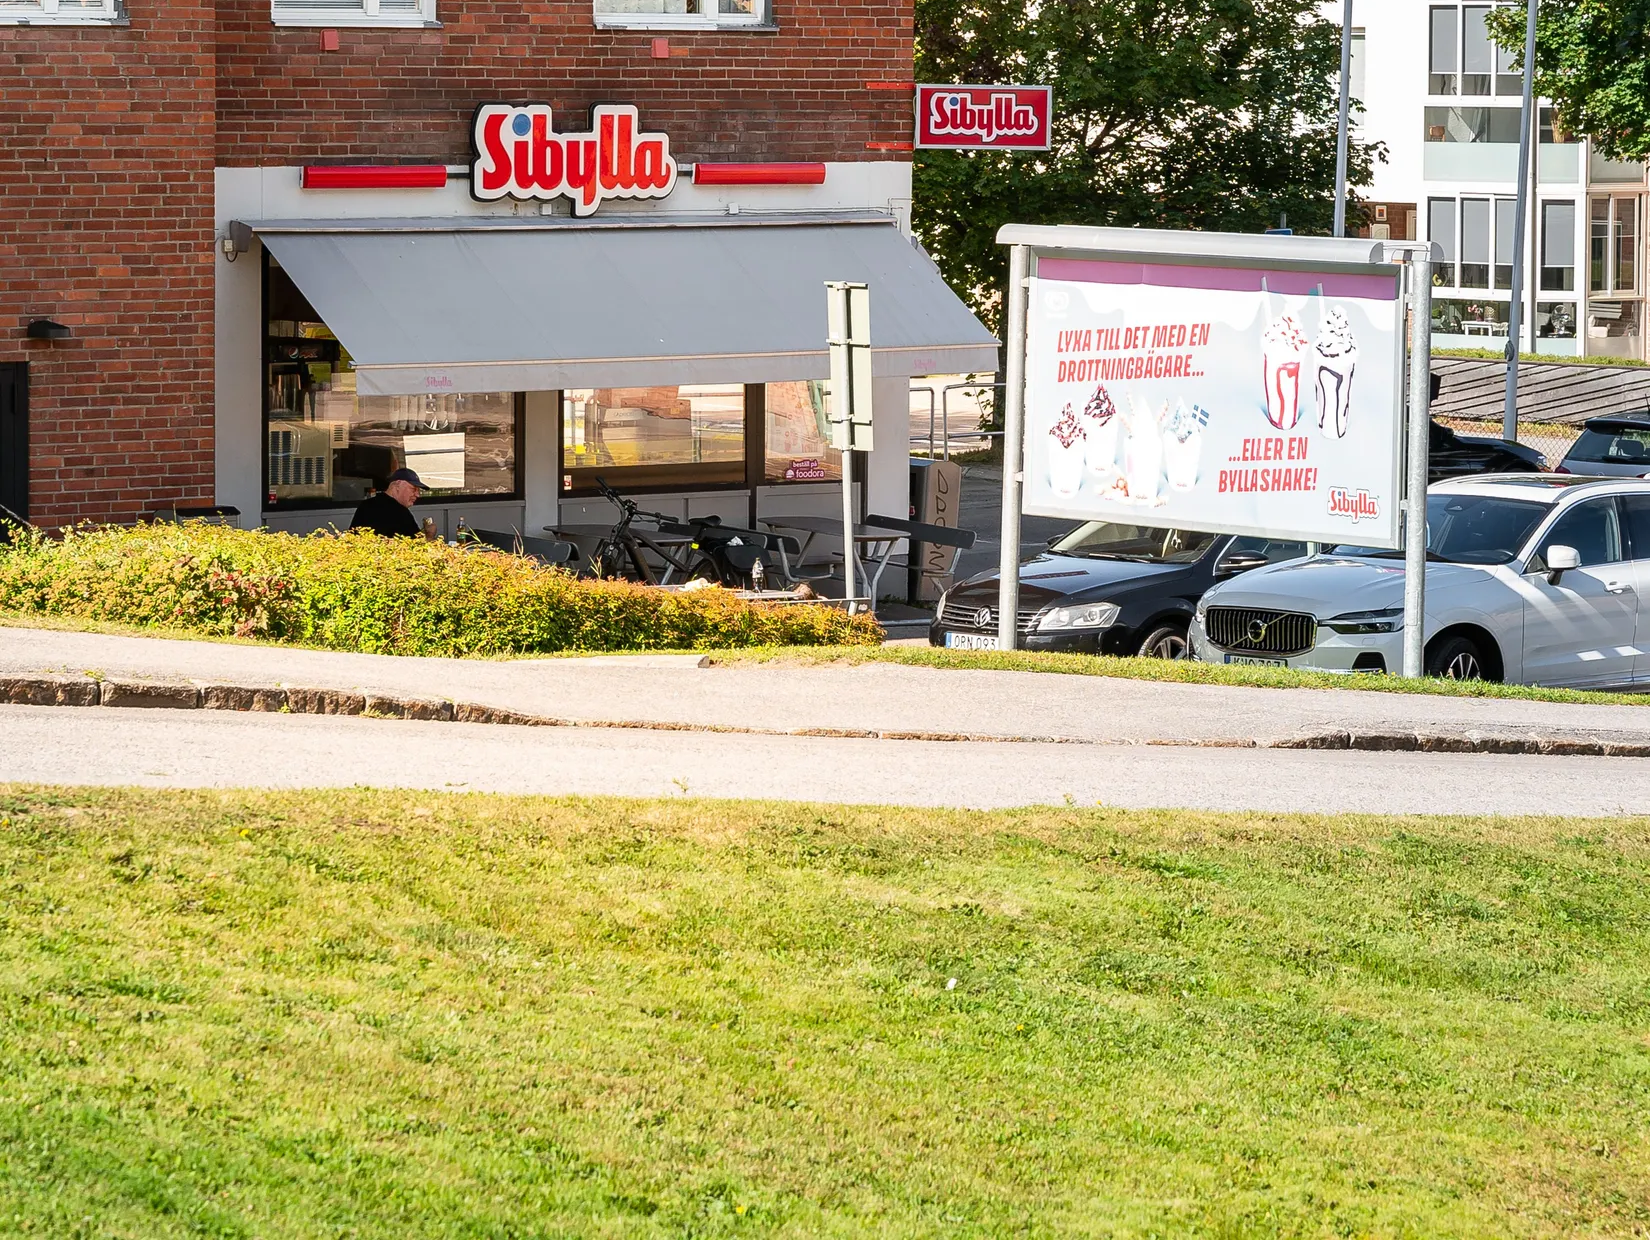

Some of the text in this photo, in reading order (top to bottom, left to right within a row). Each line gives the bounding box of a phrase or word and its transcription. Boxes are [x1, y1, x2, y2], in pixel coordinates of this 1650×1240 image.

[931, 94, 1037, 140] Sibylla
[480, 110, 672, 208] Sibylla
[1057, 322, 1211, 353] LYXA TILL DET MED EN
[1057, 350, 1205, 383] DROTTNINGBÄGARE...
[1228, 436, 1308, 462] ...ELLER EN
[795, 469, 824, 478] foodora
[810, 460, 818, 468] på
[1218, 467, 1318, 493] BYLLASHAKE!
[1330, 489, 1378, 520] Sibylla
[976, 637, 996, 650] 093
